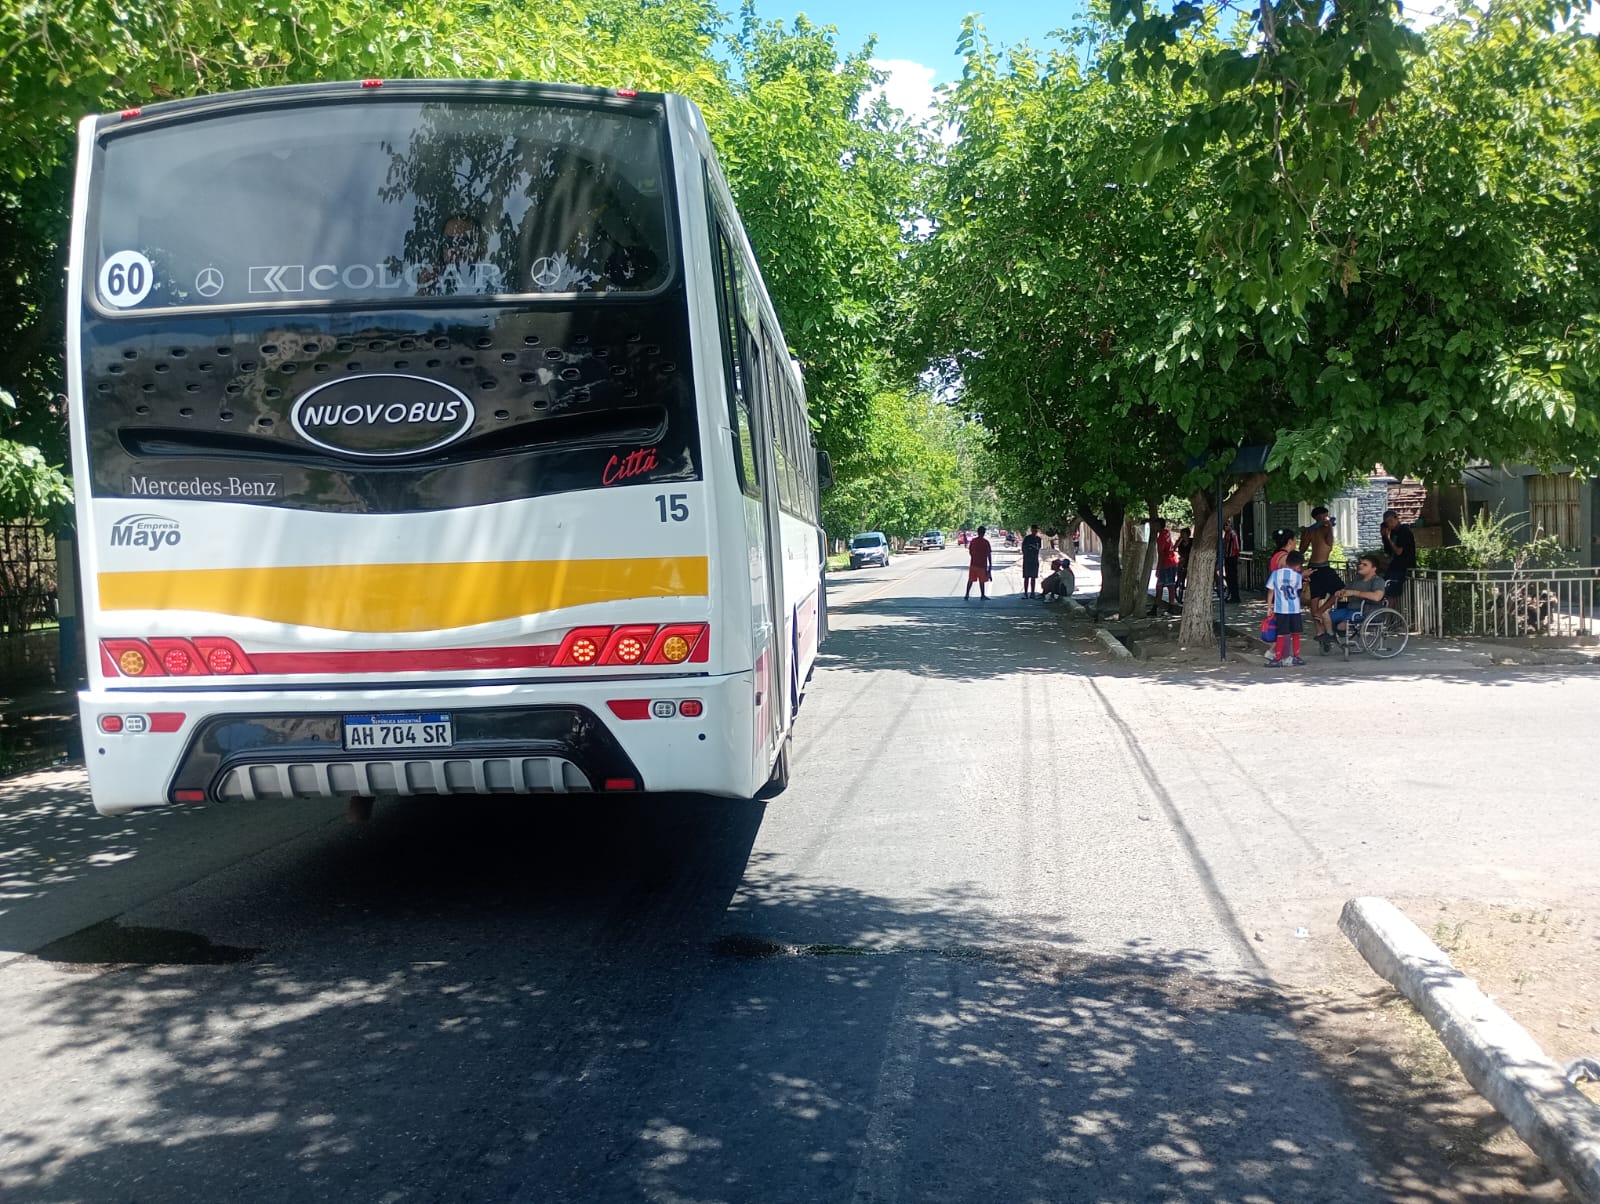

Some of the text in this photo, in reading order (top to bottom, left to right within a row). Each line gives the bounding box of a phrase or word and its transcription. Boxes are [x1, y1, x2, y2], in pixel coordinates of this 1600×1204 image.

[107, 262, 145, 294] 60
[308, 263, 504, 291] COLCAR
[304, 401, 460, 426] NUOVOBUS
[130, 476, 277, 496] Mercedes-Benz
[655, 494, 689, 522] 15
[110, 525, 181, 551] Mayo
[137, 522, 180, 530] Empresa
[1280, 585, 1296, 600] 10
[351, 724, 447, 745] AH 704 SR
